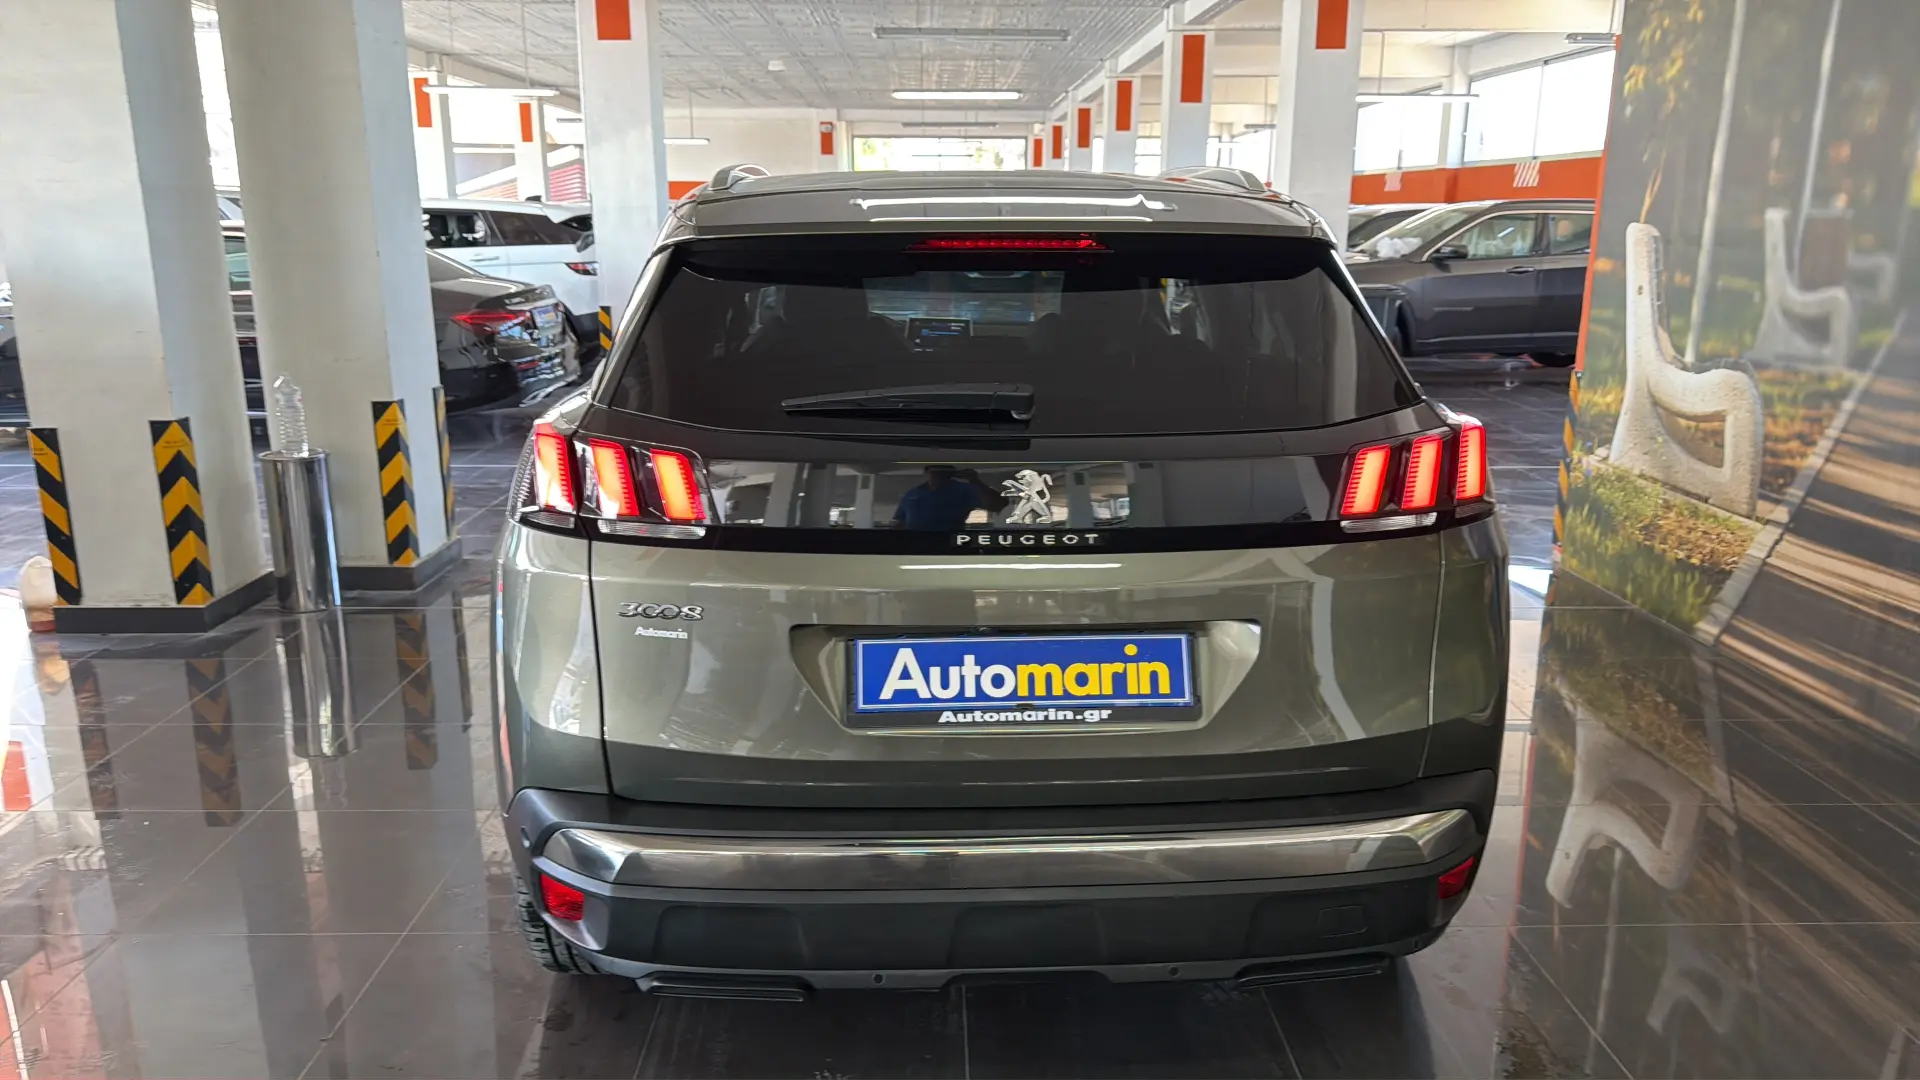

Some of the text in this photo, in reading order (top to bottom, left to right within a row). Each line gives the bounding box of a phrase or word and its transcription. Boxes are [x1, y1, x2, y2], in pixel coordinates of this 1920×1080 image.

[955, 533, 1100, 546] PEUGEOT
[616, 602, 703, 621] 3008
[878, 643, 1171, 700] Automarin
[937, 708, 1113, 723] Automarin.gr
